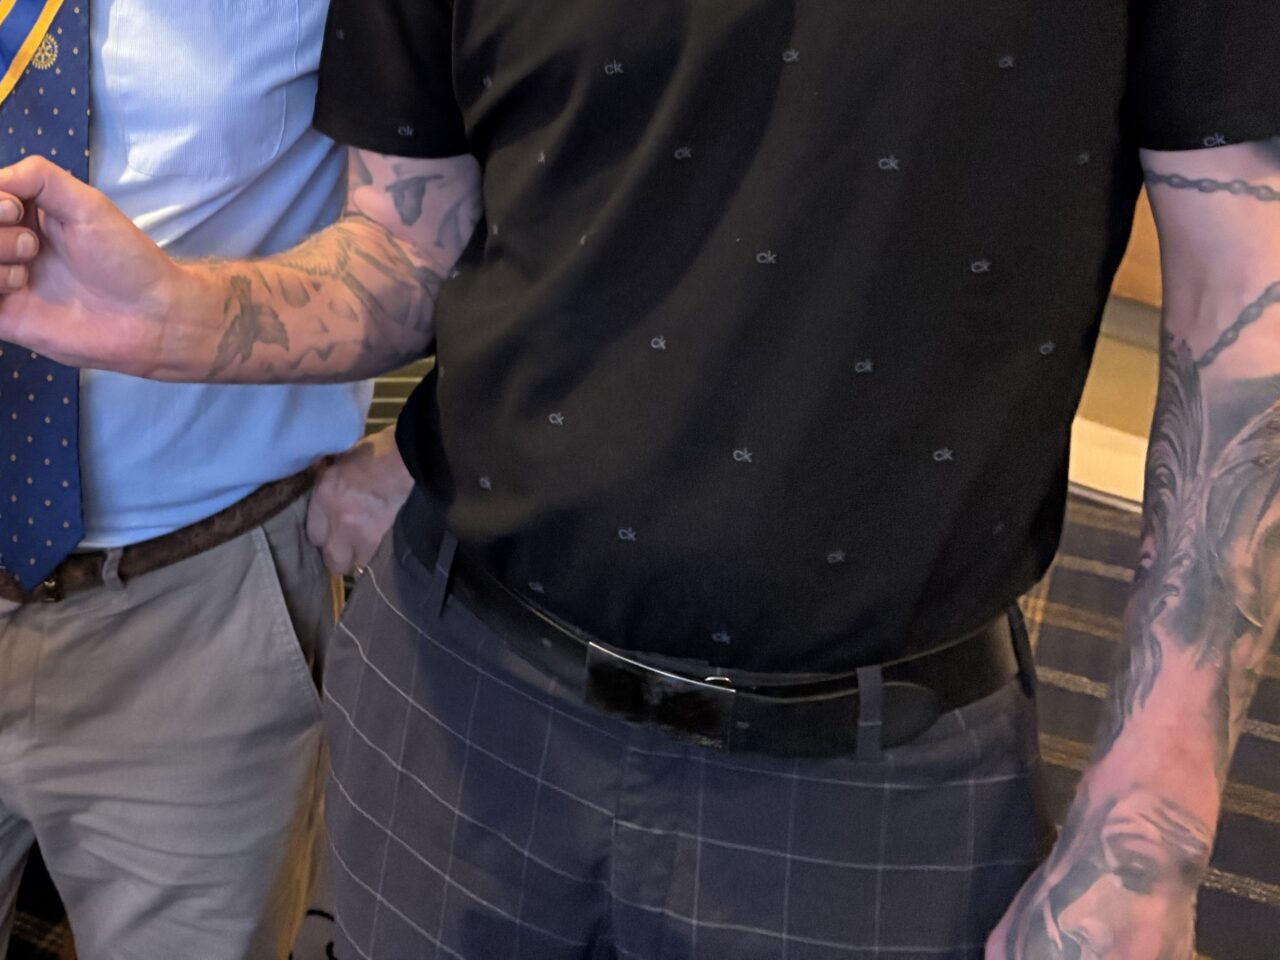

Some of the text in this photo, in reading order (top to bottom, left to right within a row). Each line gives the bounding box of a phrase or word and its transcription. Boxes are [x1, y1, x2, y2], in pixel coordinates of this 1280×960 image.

[782, 48, 801, 62] ck
[604, 59, 625, 75] ck
[397, 124, 416, 137] ck
[673, 145, 693, 160] ck
[877, 154, 900, 170] ck
[756, 249, 778, 264] ck
[650, 335, 667, 350] ck
[854, 358, 874, 373] ck
[548, 411, 565, 425] ck
[732, 446, 753, 463] ck
[933, 446, 954, 462] ck
[617, 526, 637, 541] ck
